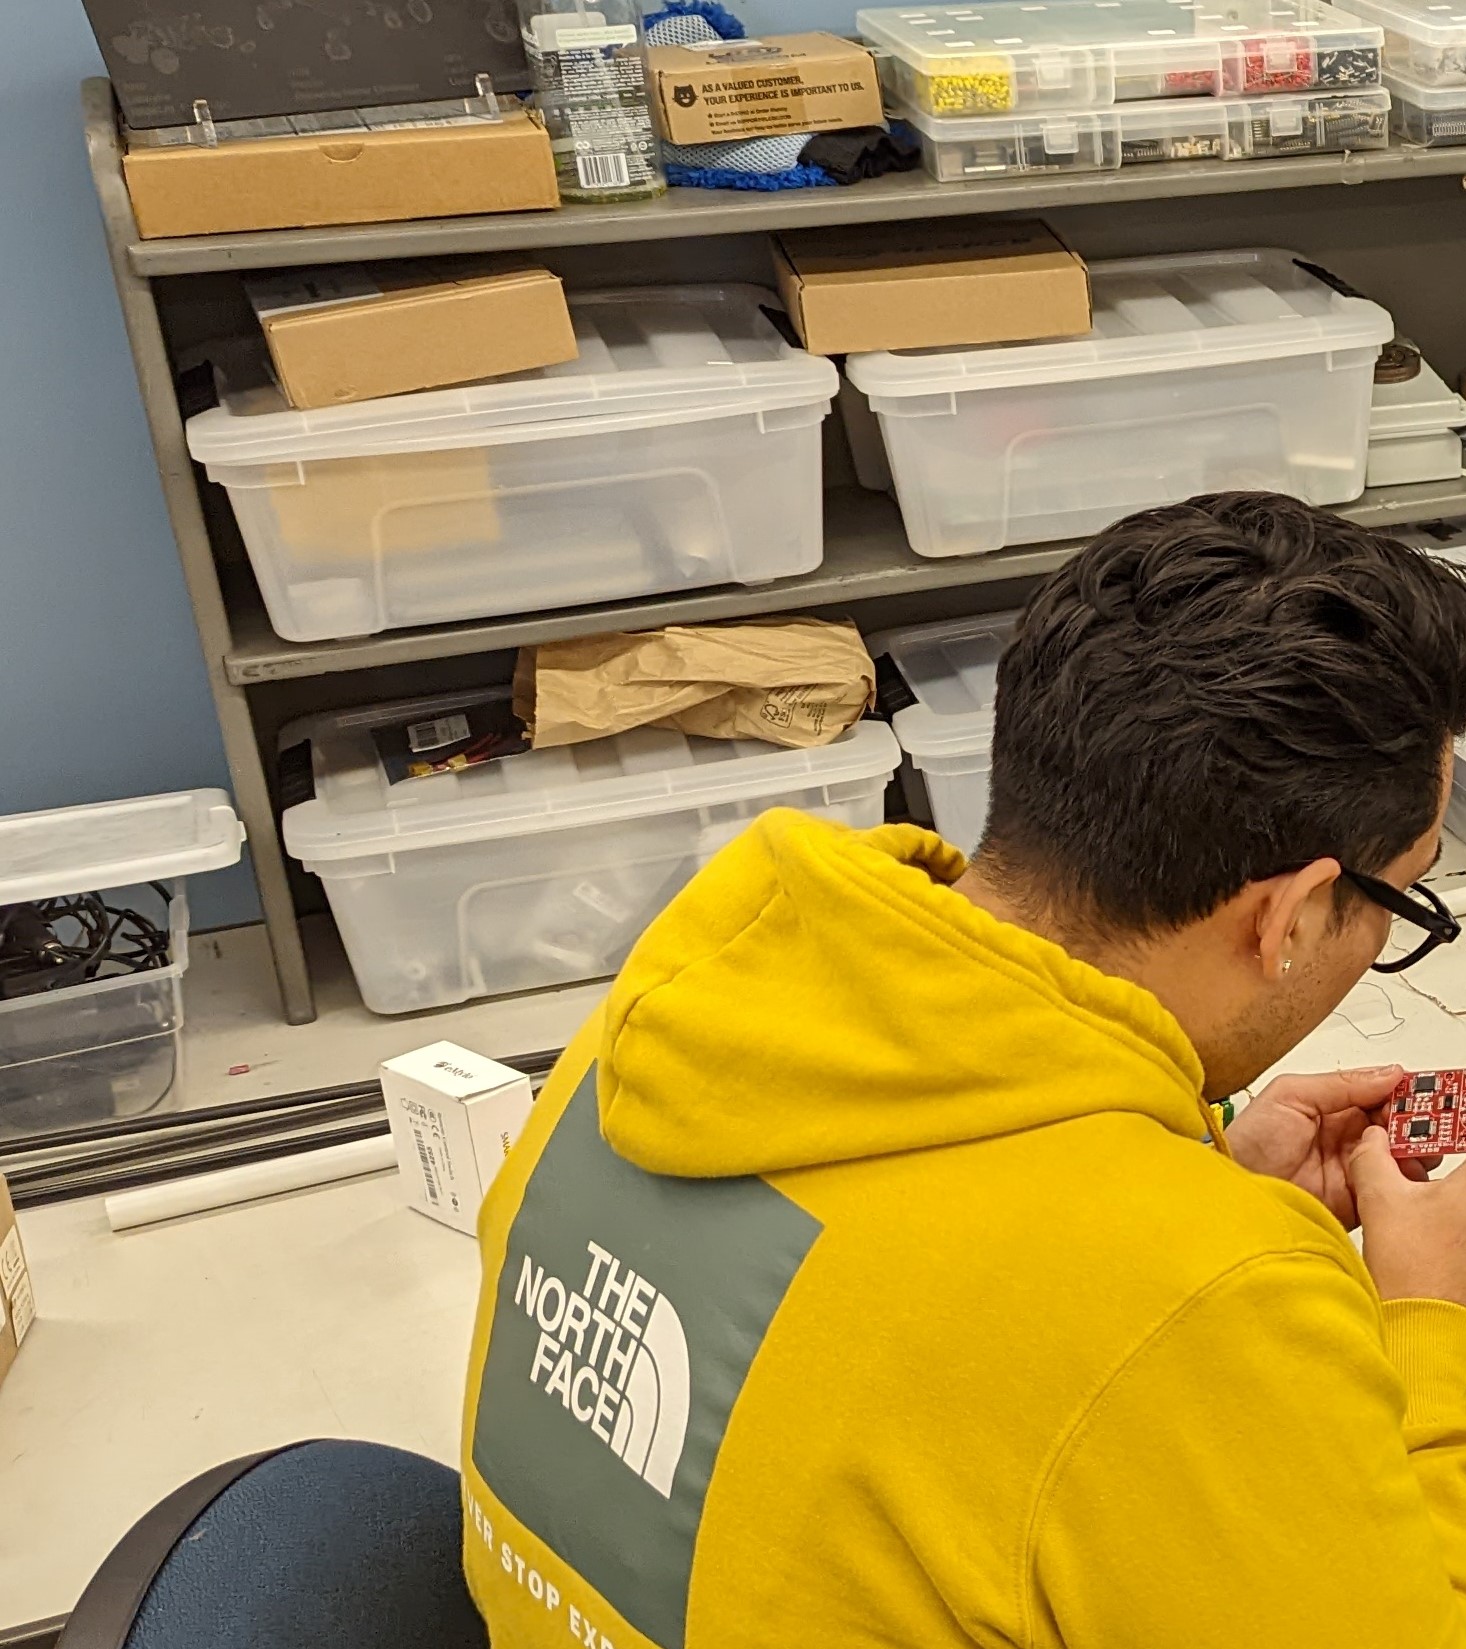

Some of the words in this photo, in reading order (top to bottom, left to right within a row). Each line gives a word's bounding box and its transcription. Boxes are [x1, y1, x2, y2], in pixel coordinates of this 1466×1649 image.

[702, 84, 714, 93] AS
[715, 83, 722, 92] A
[722, 80, 754, 91] VALUED
[756, 76, 804, 88] CUSTOMER,
[703, 95, 727, 105] YOUR
[728, 90, 778, 103] EXPERIENCE
[780, 89, 790, 98] IS
[790, 84, 837, 97] IMPORTANT
[838, 83, 849, 92] TO
[514, 1254, 638, 1392] NORTH
[583, 1240, 657, 1338] THE
[530, 1332, 621, 1444] FACE
[501, 1542, 560, 1611] STOP
